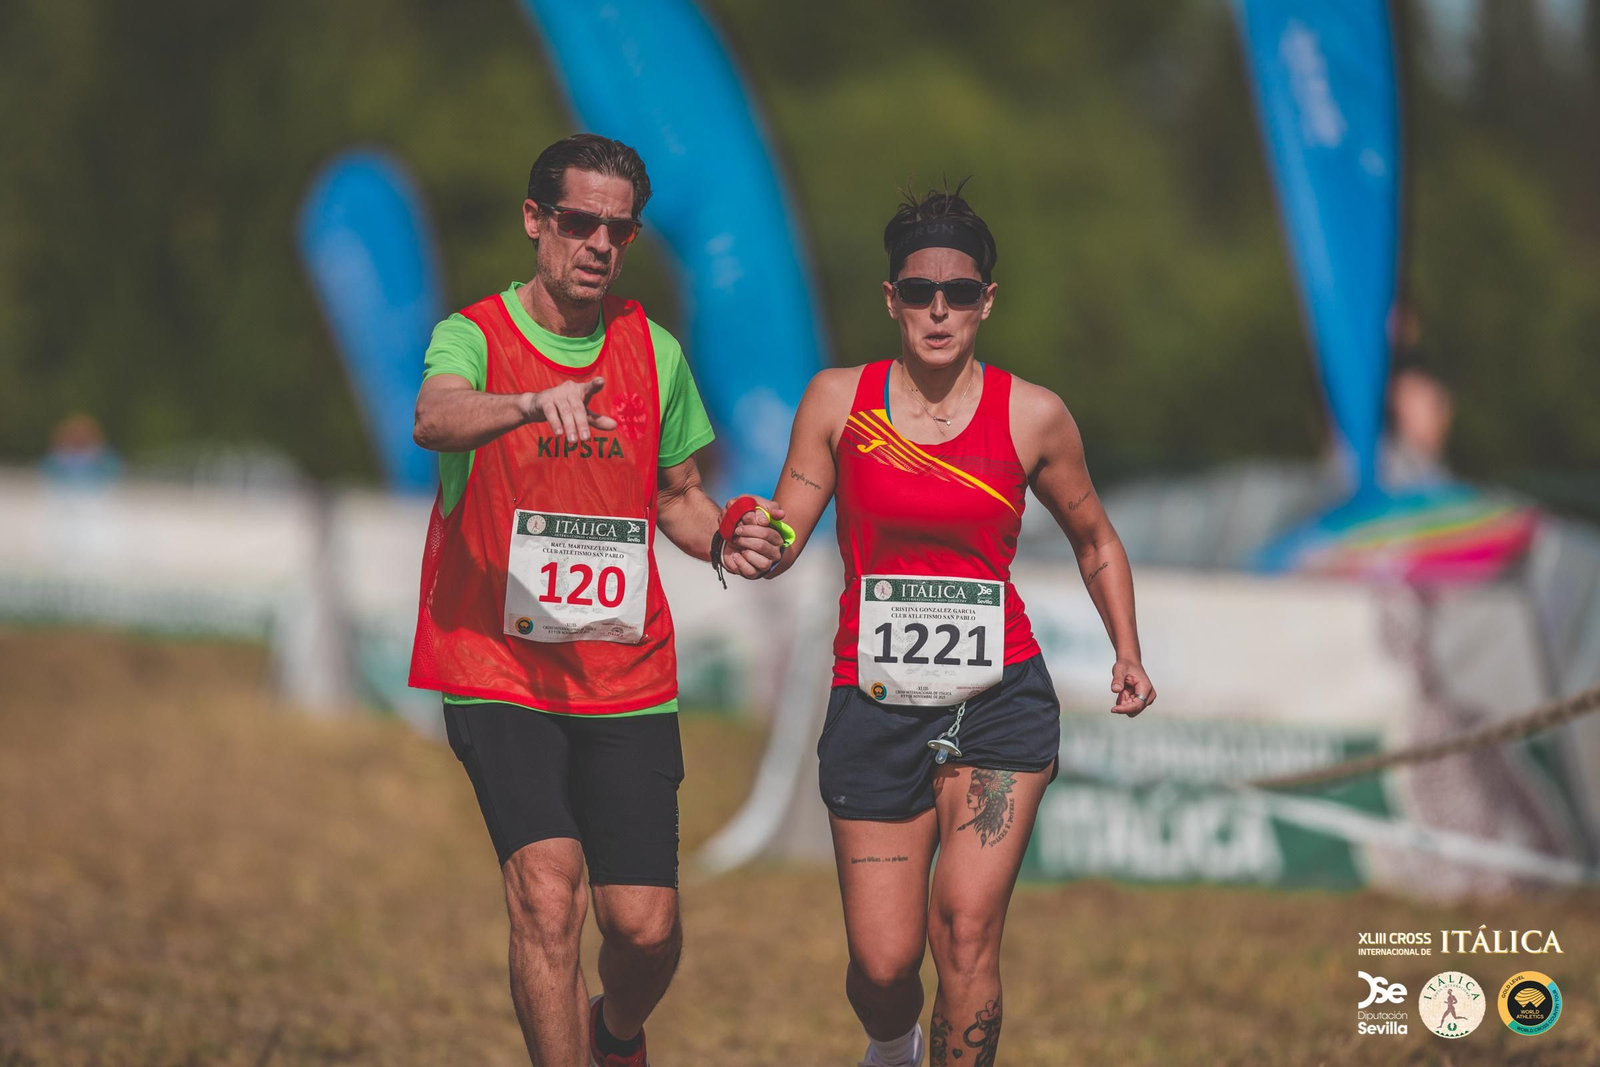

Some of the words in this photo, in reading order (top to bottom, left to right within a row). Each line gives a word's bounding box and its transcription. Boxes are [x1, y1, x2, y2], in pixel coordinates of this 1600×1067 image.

[537, 436, 625, 459] KIPSTA
[554, 518, 618, 538] ITÁLICA
[559, 549, 592, 557] ATLETISMO
[539, 562, 626, 608] 120
[901, 581, 967, 599] ITÁLICA
[874, 622, 992, 666] 1221
